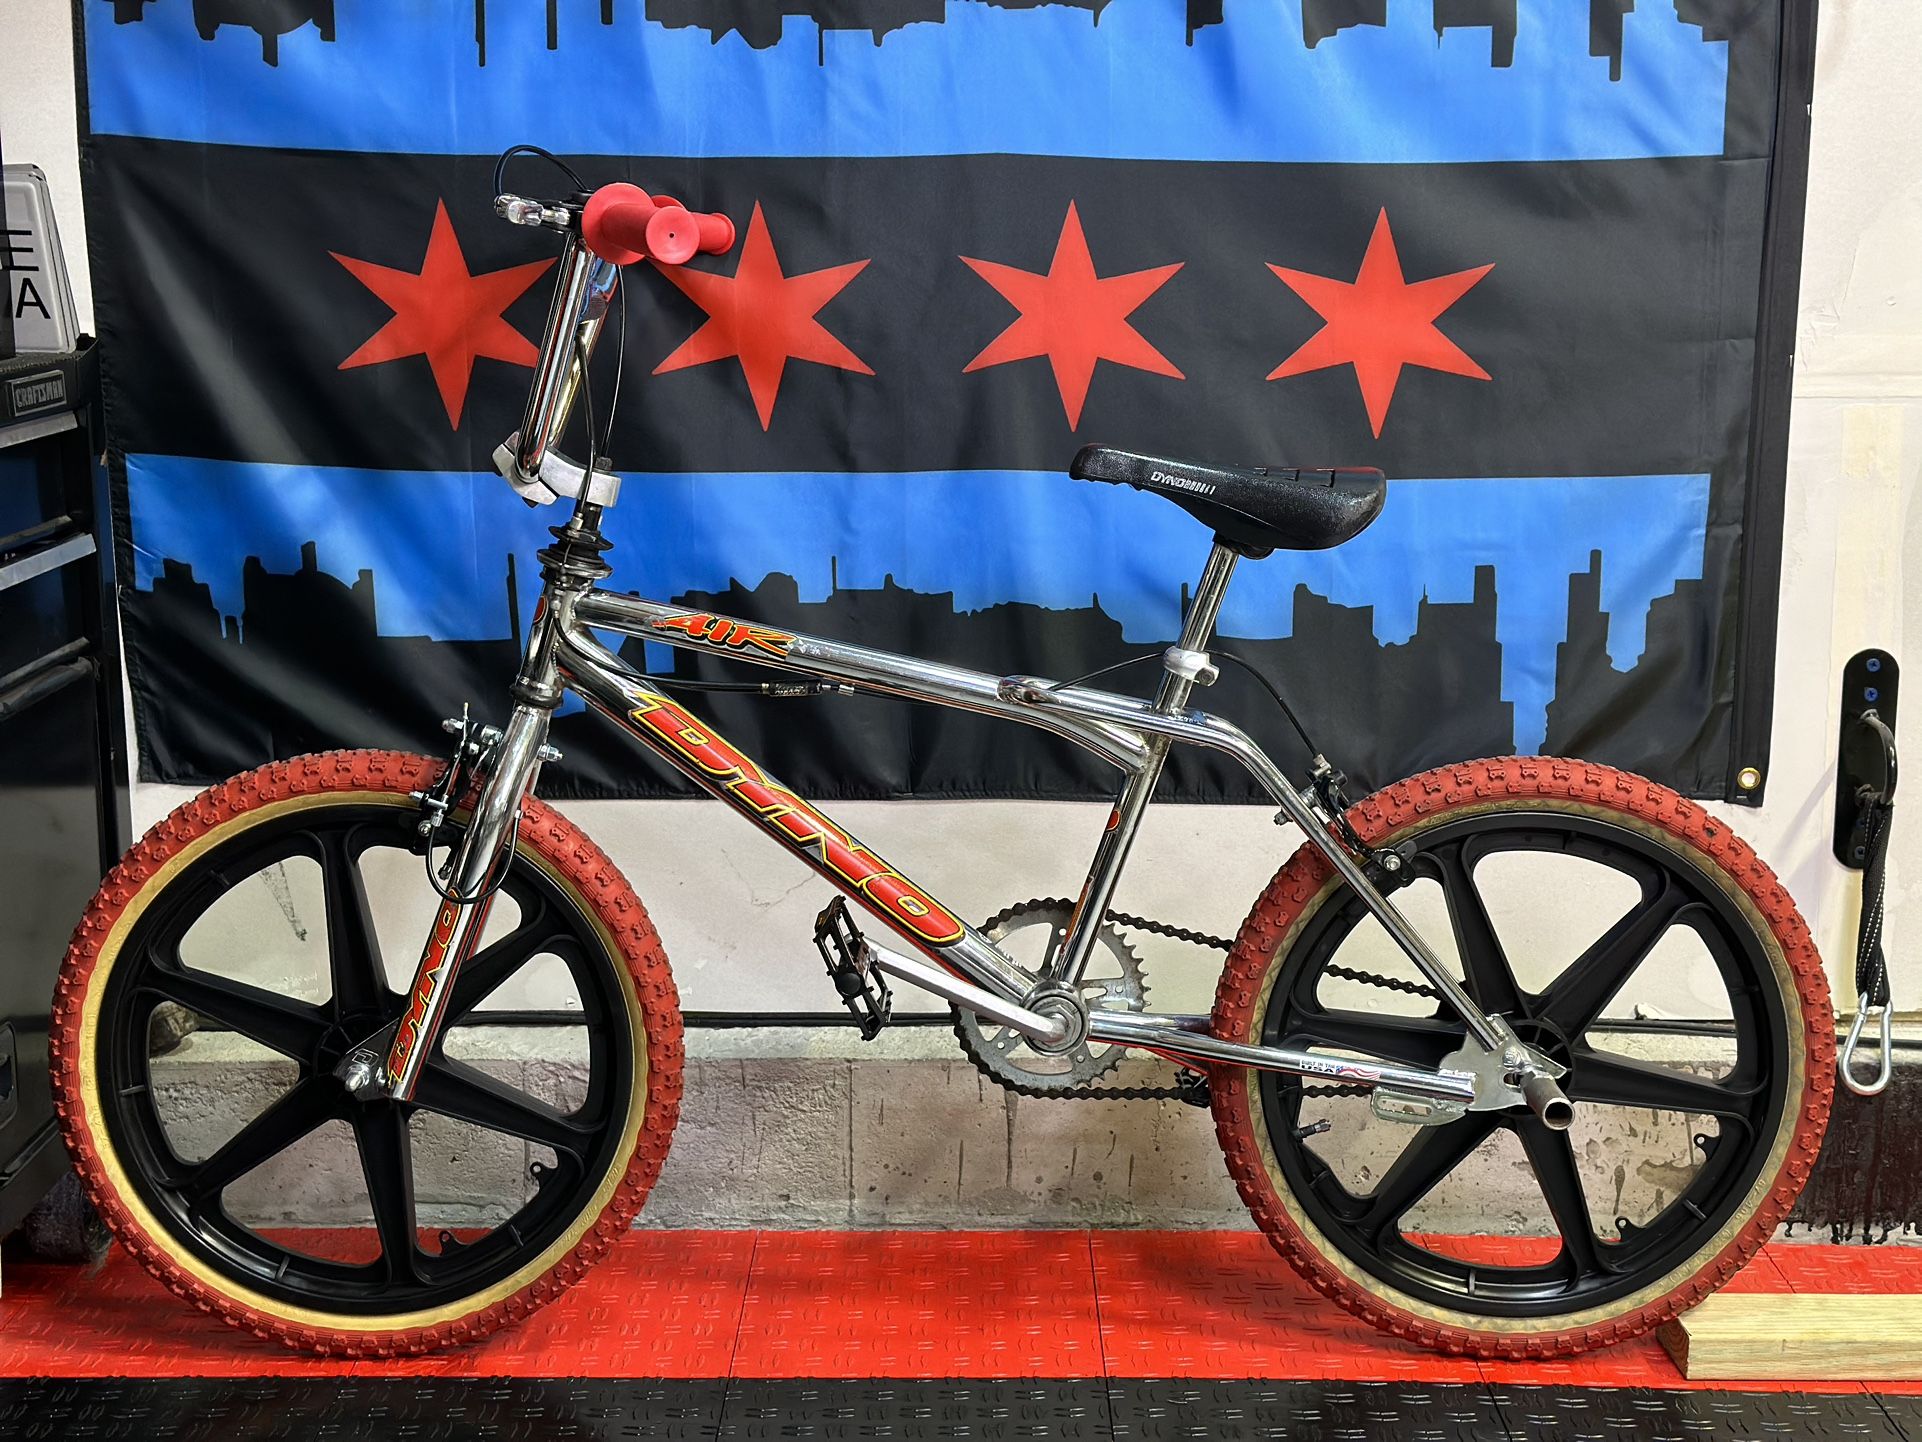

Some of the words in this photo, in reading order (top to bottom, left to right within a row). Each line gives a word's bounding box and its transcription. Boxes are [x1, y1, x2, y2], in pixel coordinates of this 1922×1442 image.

[15, 380, 63, 408] CRAFTSMAN
[651, 612, 798, 661] AIR
[628, 691, 966, 944] DYNO
[1301, 1065, 1334, 1073] USA
